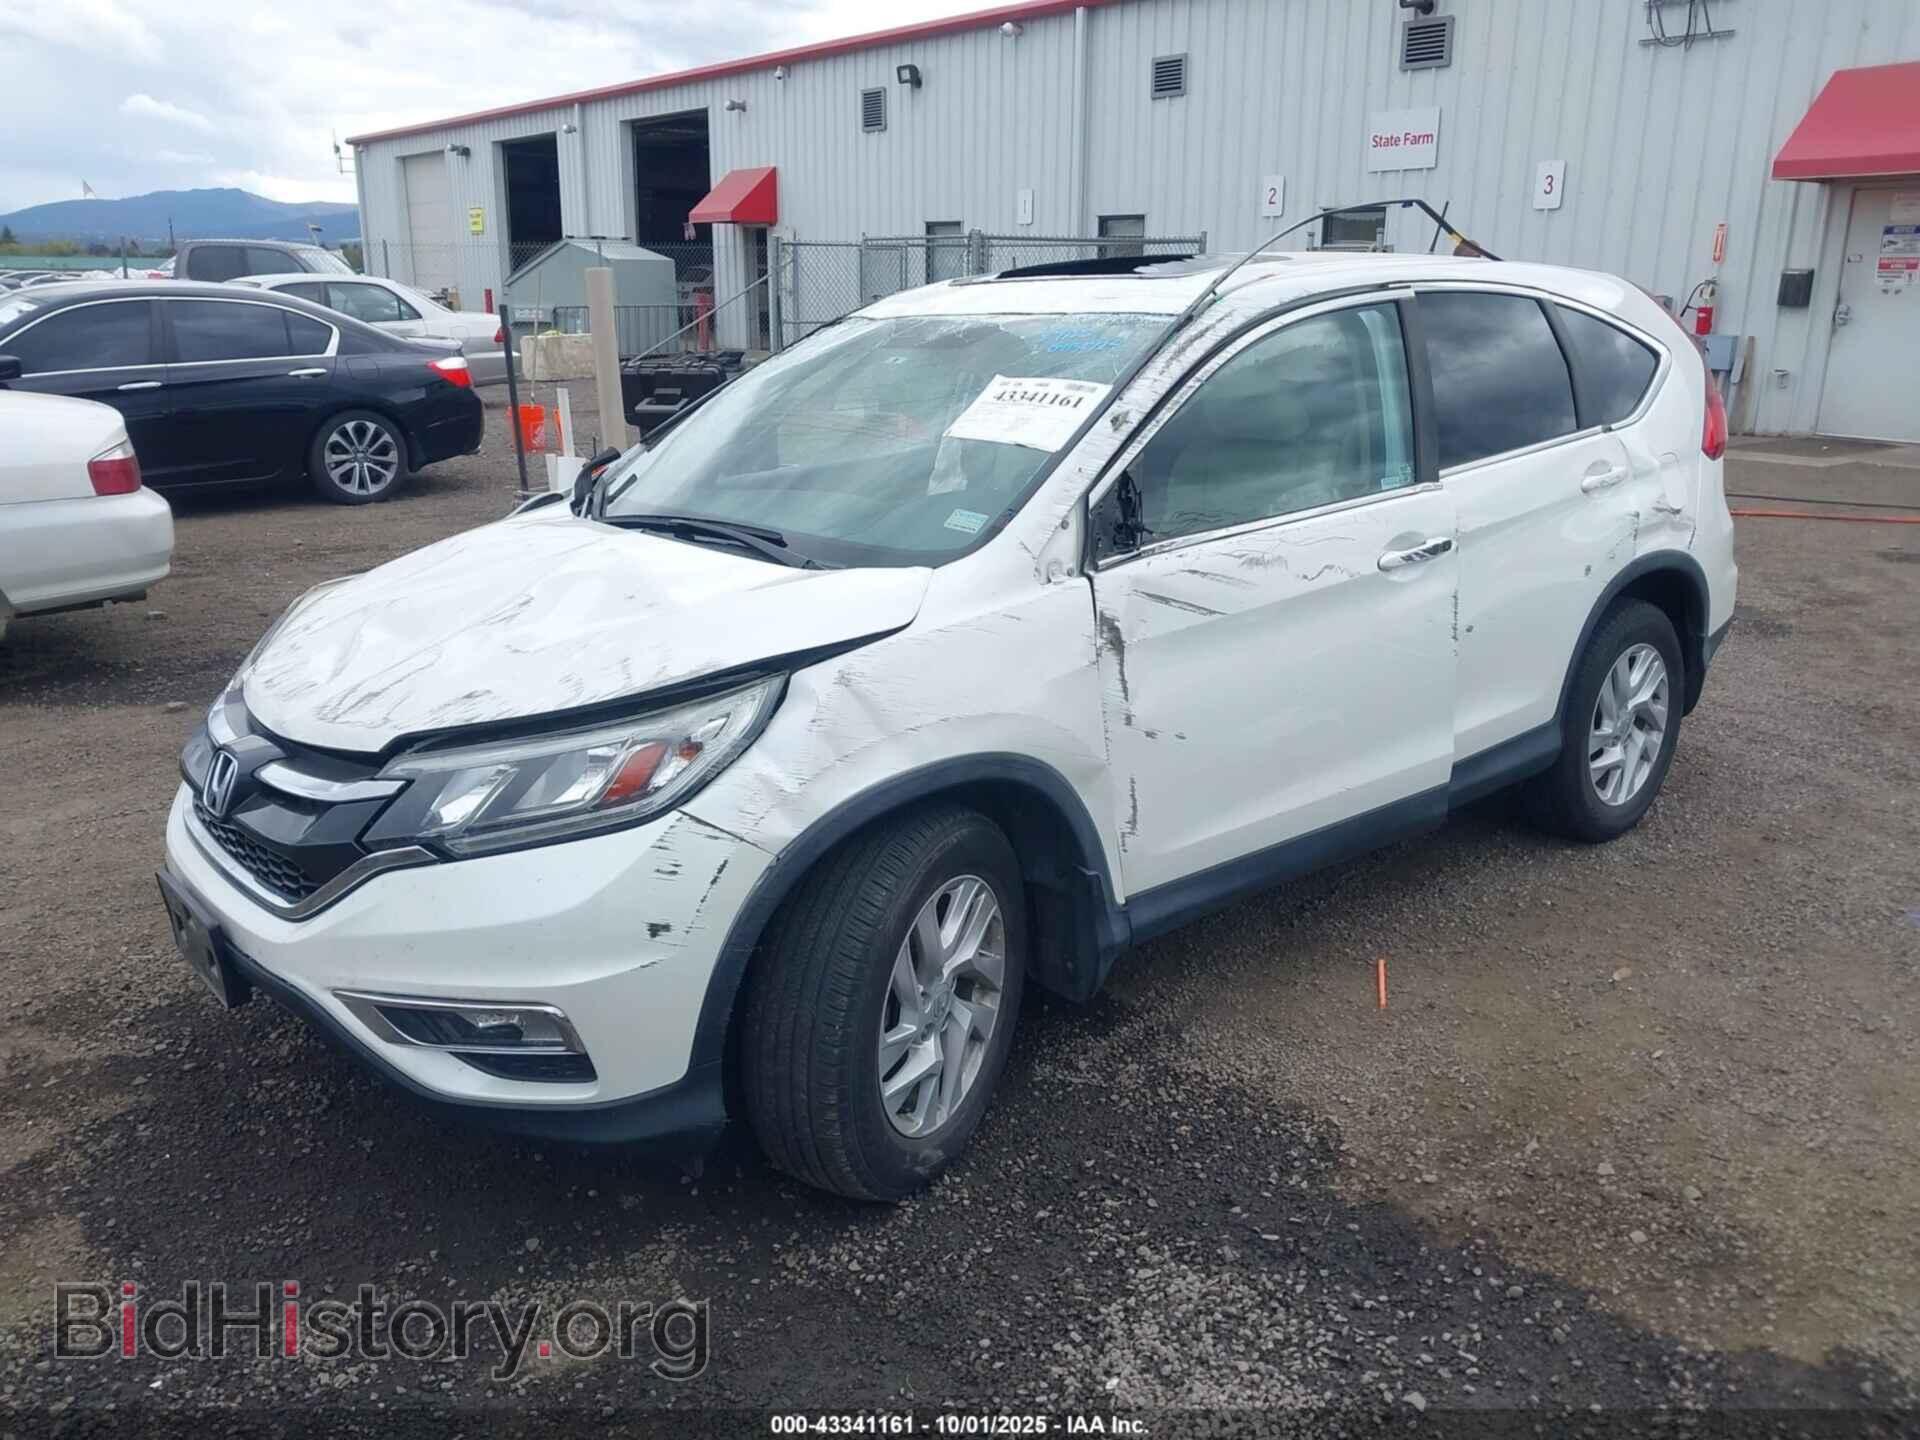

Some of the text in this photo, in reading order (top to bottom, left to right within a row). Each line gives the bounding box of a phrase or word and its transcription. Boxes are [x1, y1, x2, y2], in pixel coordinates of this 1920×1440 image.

[1372, 132, 1434, 148] State Farm
[1543, 174, 1554, 195] 3
[1268, 187, 1277, 205] 2
[993, 390, 1084, 408] 43341161
